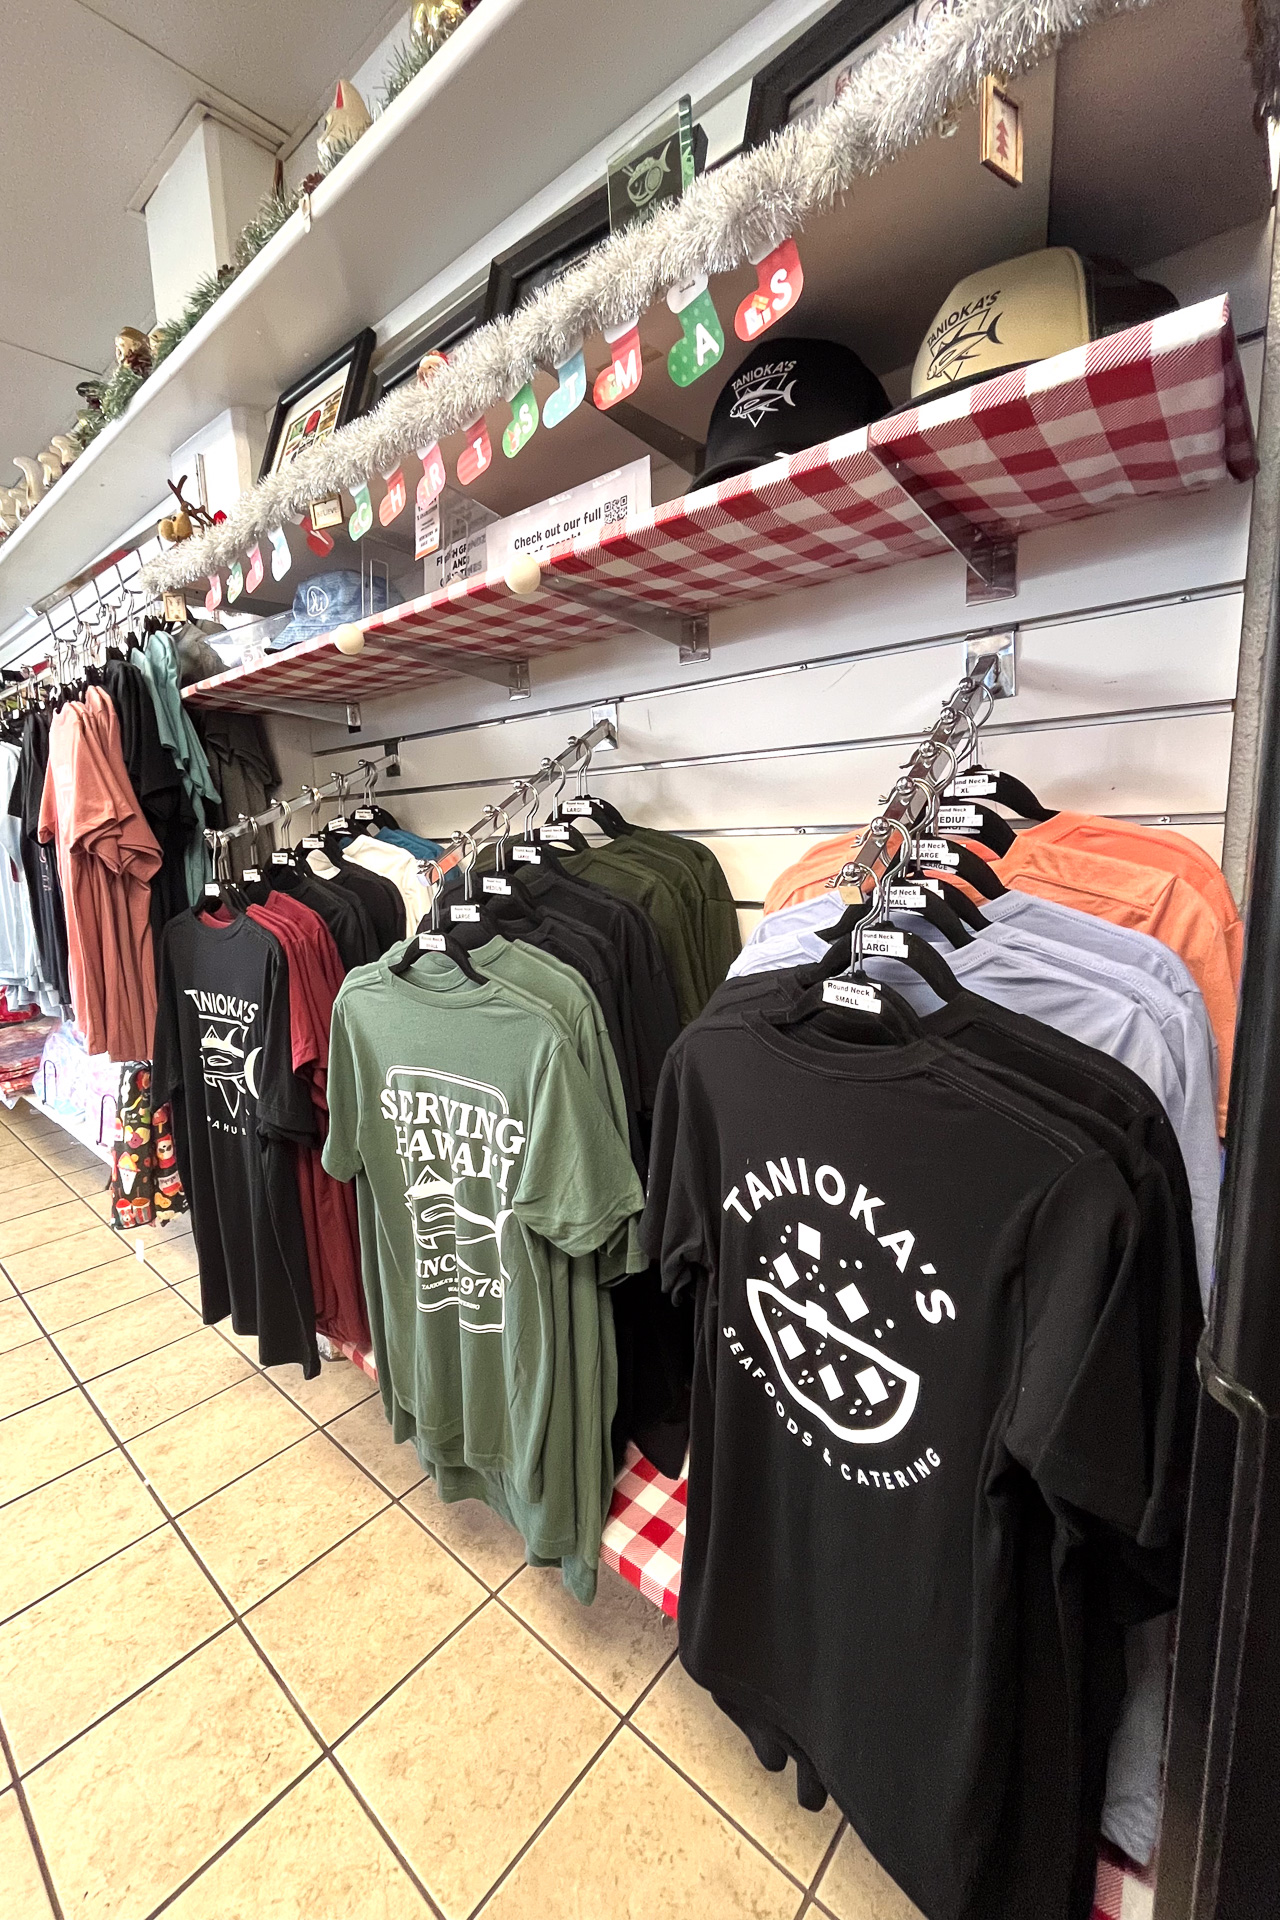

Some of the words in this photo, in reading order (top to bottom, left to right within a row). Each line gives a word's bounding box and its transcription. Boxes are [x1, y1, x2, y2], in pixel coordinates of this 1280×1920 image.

[926, 290, 1001, 348] TANIOKA'S
[731, 360, 797, 391] TANIOKA'S
[514, 531, 542, 550] Check
[545, 524, 561, 539] out
[563, 517, 581, 532] our
[584, 507, 601, 524] full
[827, 982, 849, 992] Round
[850, 986, 870, 997] Neck
[835, 995, 859, 1006] SMALL
[380, 1088, 527, 1155] SERVING
[722, 1157, 956, 1325] TANIOKA'S
[723, 1326, 813, 1447] SEAFOODS
[840, 1447, 941, 1490] CATERING
